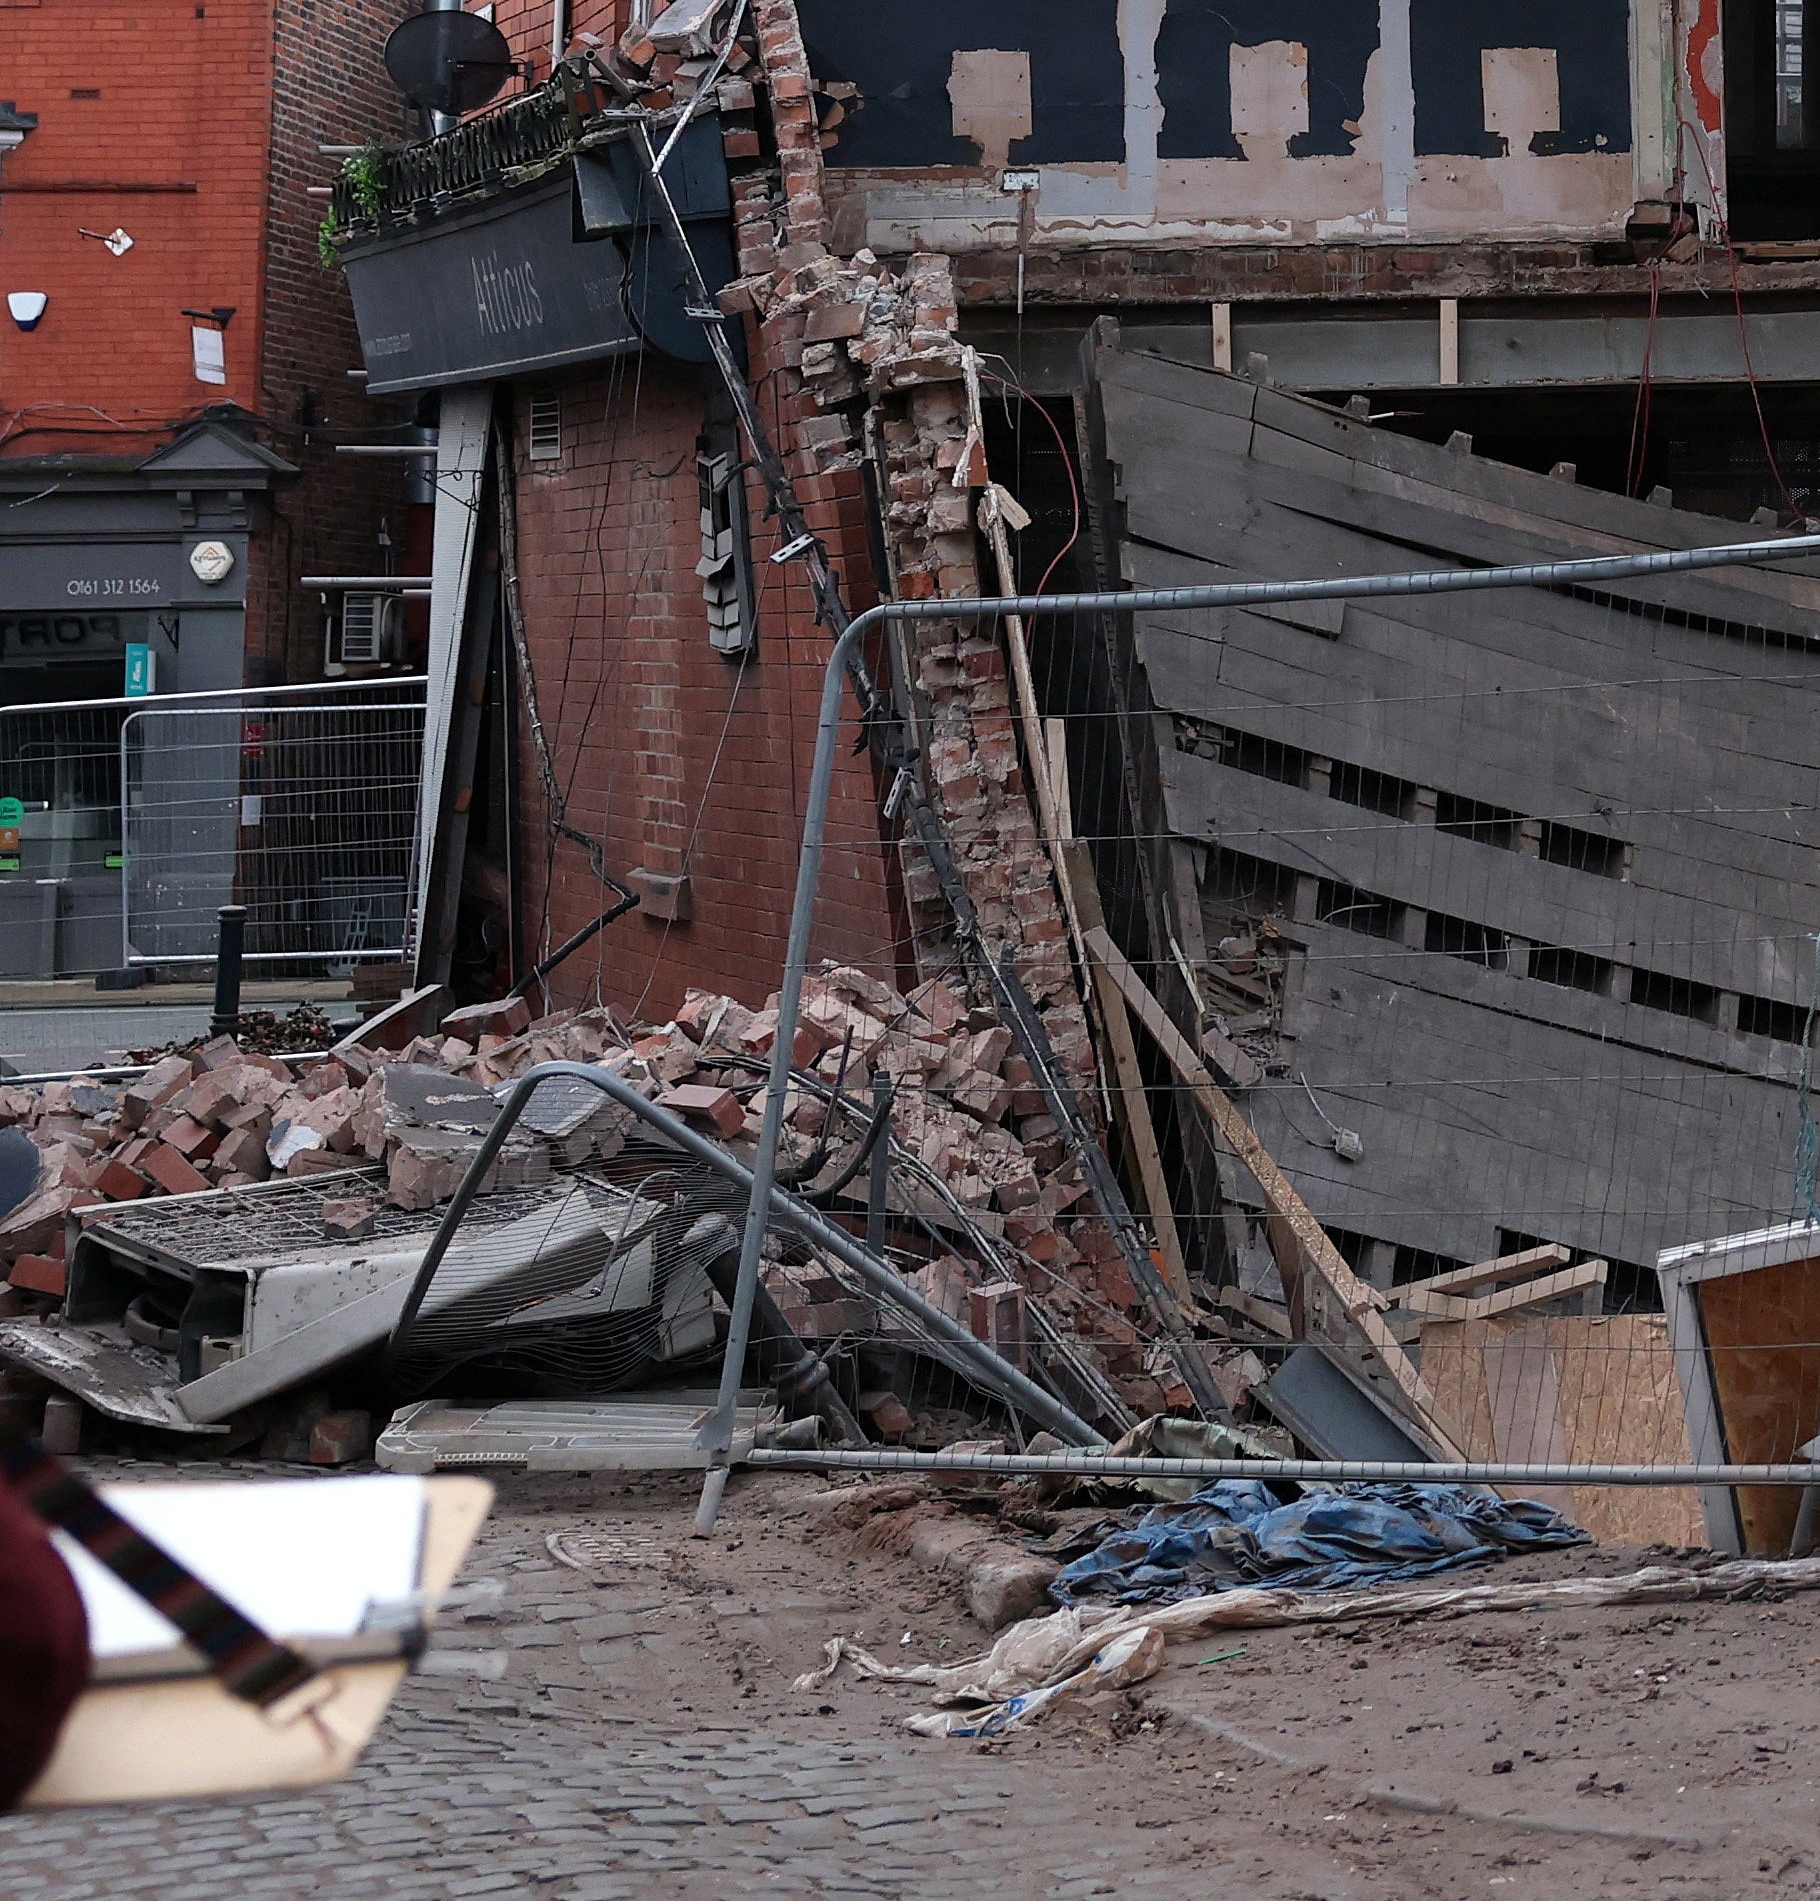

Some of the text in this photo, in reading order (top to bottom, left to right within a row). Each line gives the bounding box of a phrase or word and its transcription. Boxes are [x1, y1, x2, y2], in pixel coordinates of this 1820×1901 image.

[67, 578, 161, 596] 0161 312 1564
